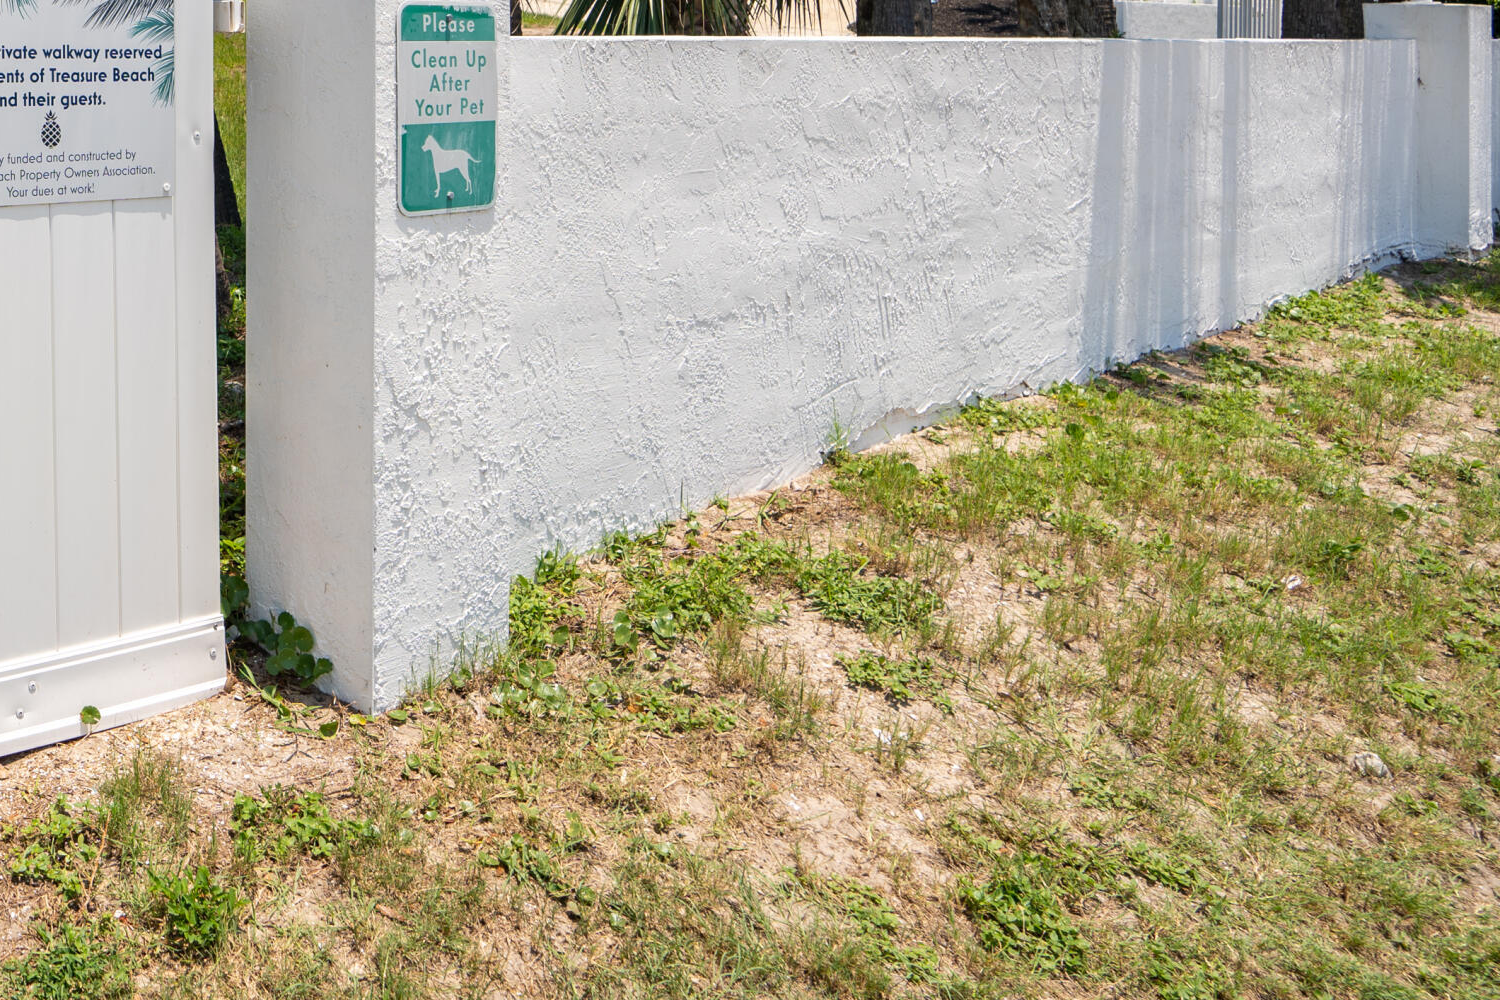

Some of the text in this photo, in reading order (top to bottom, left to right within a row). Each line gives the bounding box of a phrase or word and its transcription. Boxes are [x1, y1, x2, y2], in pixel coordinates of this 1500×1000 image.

[422, 13, 475, 32] Please
[43, 45, 100, 62] walkway
[104, 45, 162, 59] reserved
[411, 48, 486, 72] Clean Up
[30, 68, 44, 83] of
[50, 68, 107, 82] Treasure
[113, 67, 154, 82] Beach
[430, 72, 470, 92] After
[23, 92, 55, 106] their
[61, 92, 106, 109] guests.
[415, 98, 484, 117] Your Pet
[7, 152, 42, 164] funded
[46, 152, 64, 162] and
[69, 150, 122, 161] constructed
[126, 149, 136, 161] by
[20, 170, 60, 182] Property
[64, 167, 99, 178] Owners
[103, 166, 155, 176] Association.
[7, 183, 94, 197] Your dues at work!
